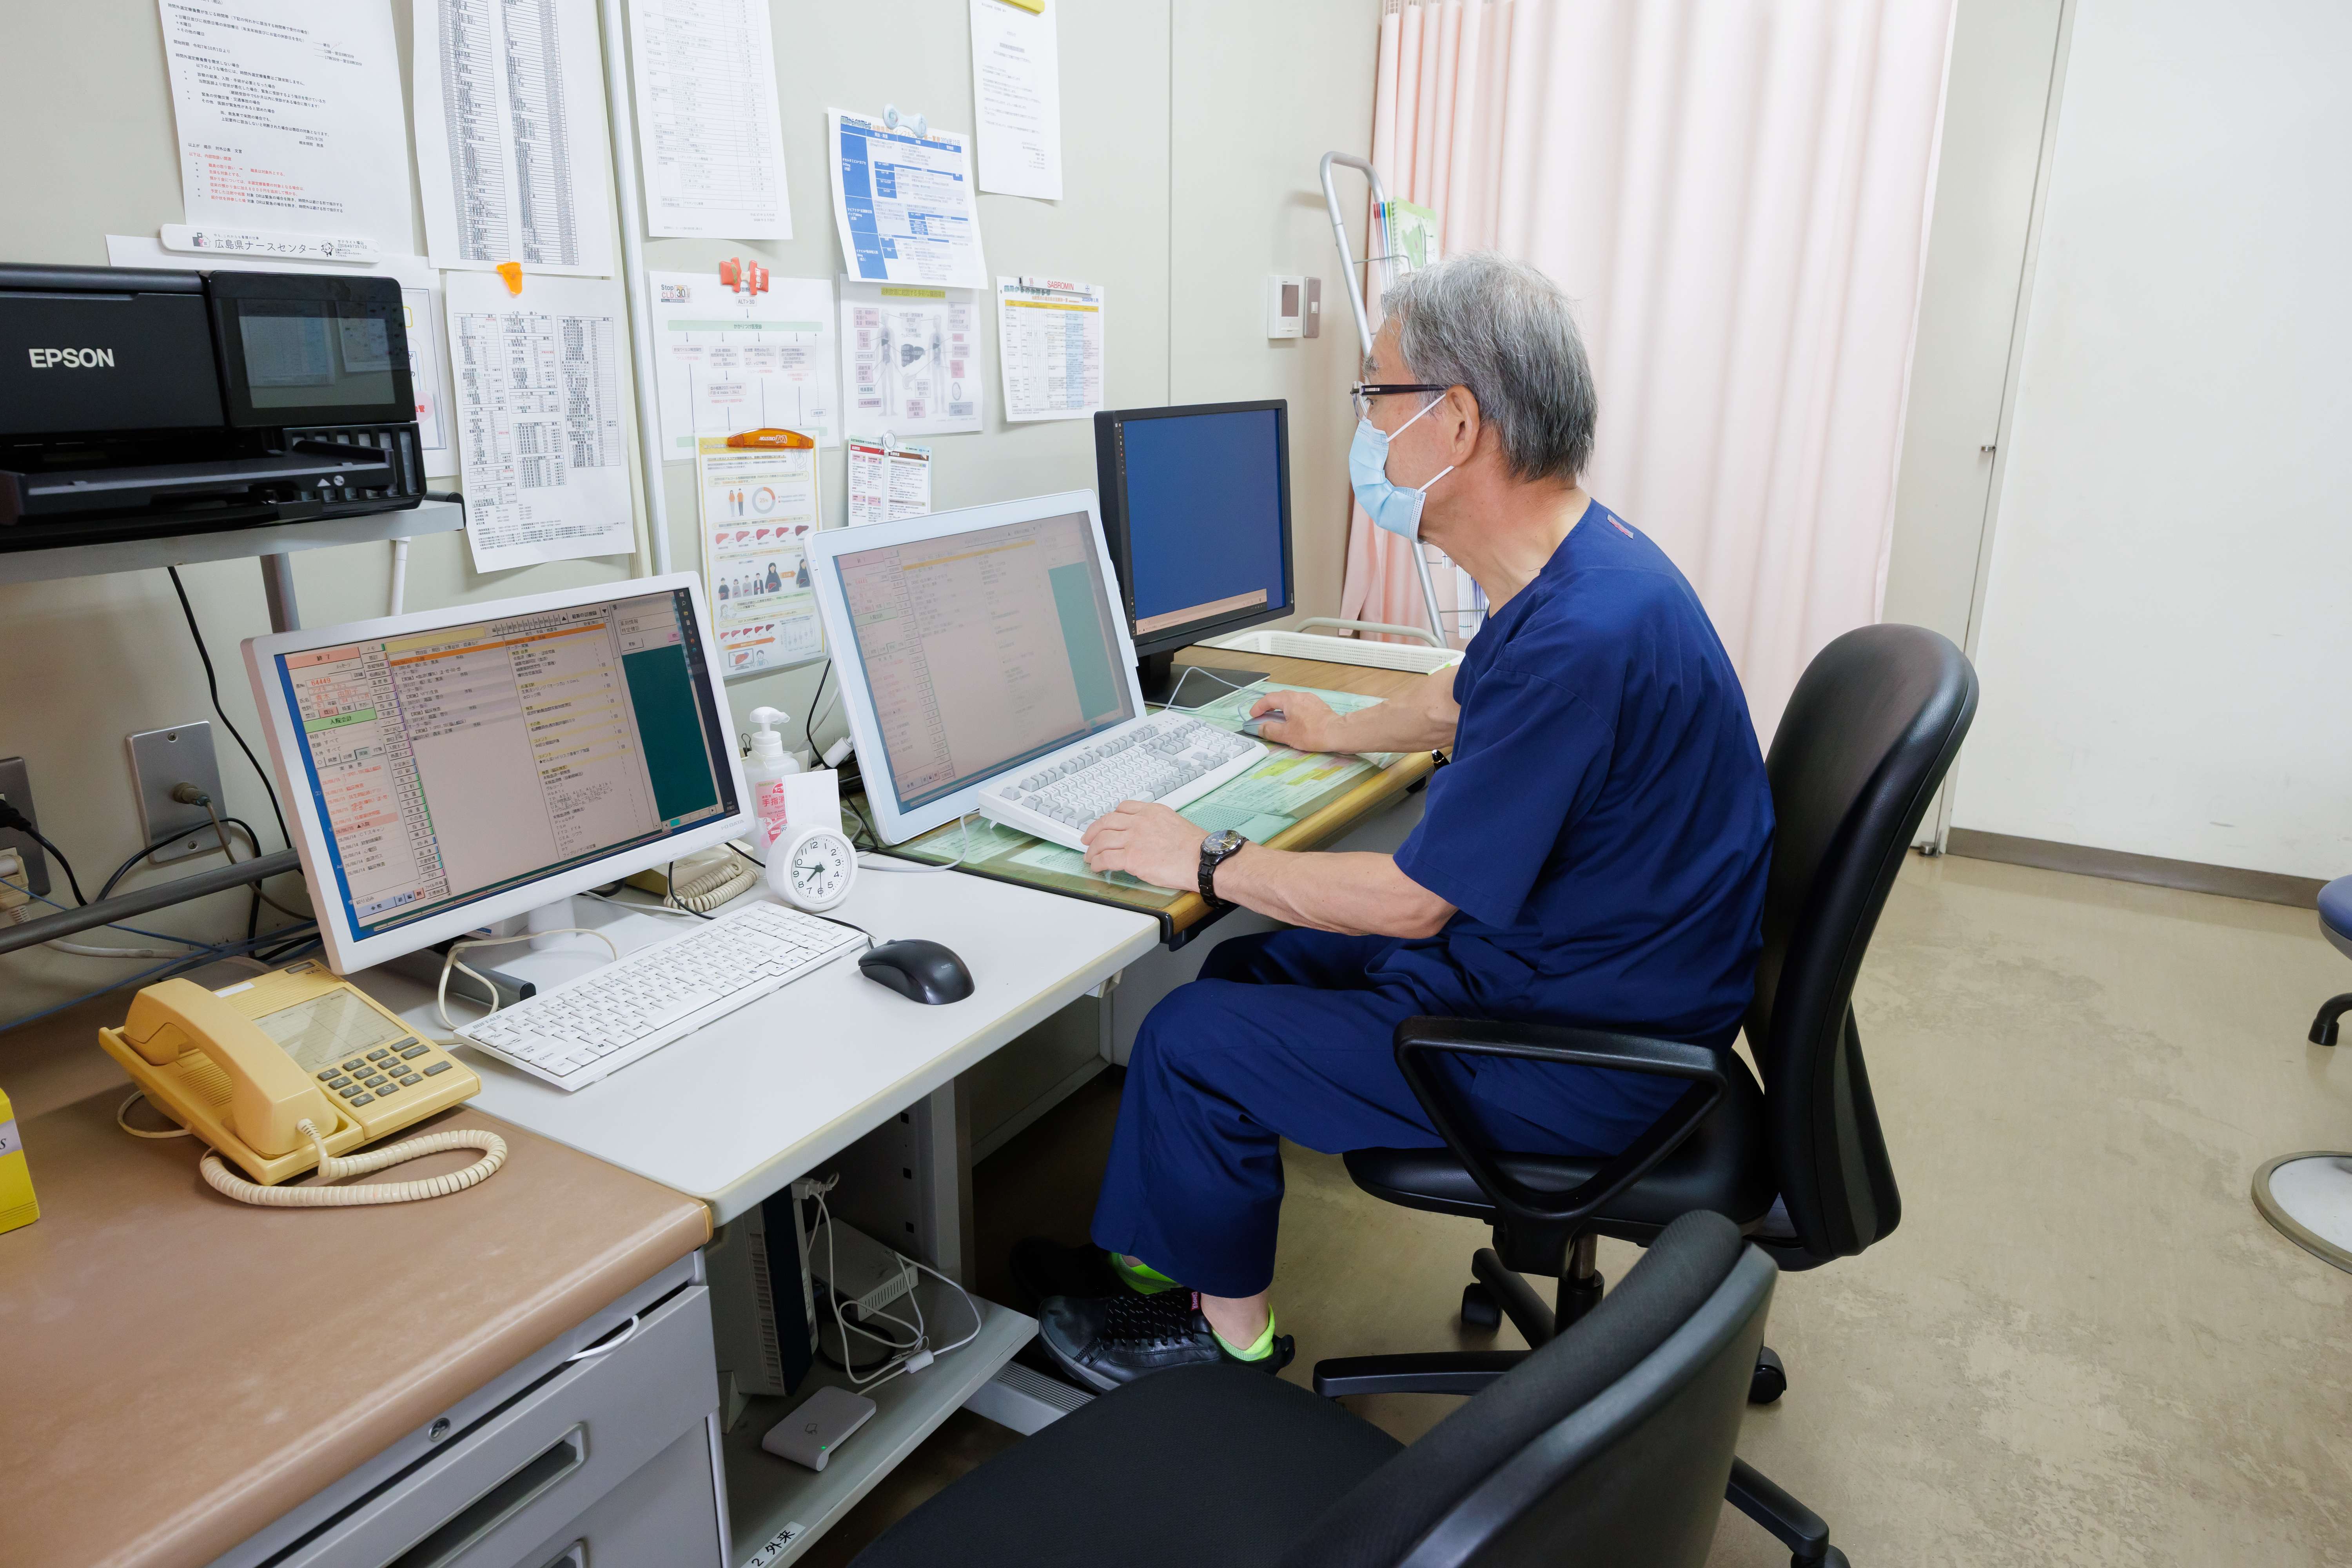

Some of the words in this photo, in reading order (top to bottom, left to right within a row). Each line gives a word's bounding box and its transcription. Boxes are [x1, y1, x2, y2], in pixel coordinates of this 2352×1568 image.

[180, 28, 205, 36] その他の曜日
[193, 43, 230, 54] 令和7年10月1日より
[215, 239, 318, 254] 広島県ナースセンター
[1047, 280, 1074, 291] SABROMIN
[676, 289, 686, 298] 30
[29, 348, 114, 368] EPSON
[619, 618, 639, 627] 薬剤情報
[621, 625, 640, 633] 特定健診
[328, 715, 352, 726] 入院会計
[321, 729, 337, 737] すべて
[326, 746, 342, 754] すべて
[408, 814, 423, 822] その他
[356, 895, 375, 906] 絞り込み
[472, 1014, 502, 1029] BUFFALO
[751, 1558, 764, 1567] 2
[765, 1530, 796, 1555] 外来
